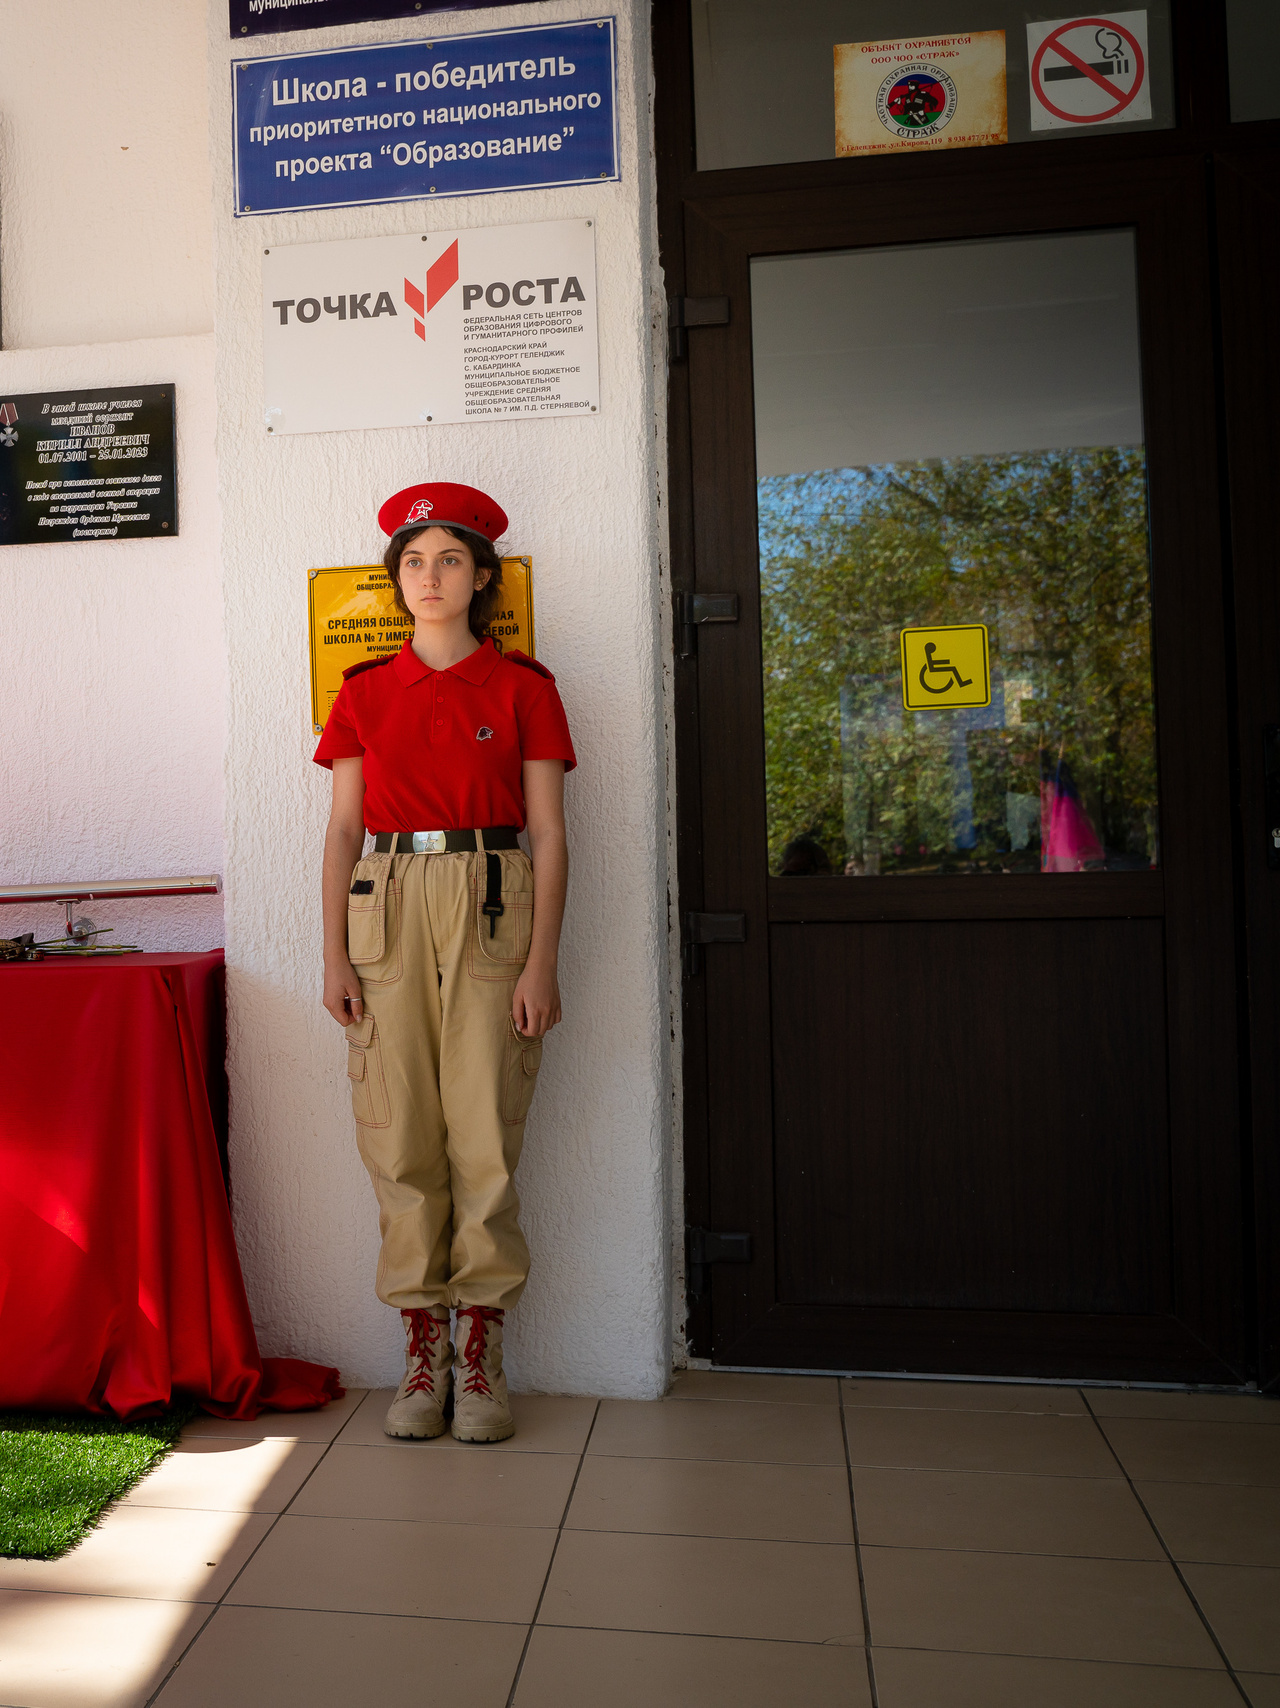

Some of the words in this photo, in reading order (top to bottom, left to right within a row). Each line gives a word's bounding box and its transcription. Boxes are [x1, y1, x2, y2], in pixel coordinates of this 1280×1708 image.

[871, 56, 891, 64] ООО
[916, 50, 960, 60] «СТРАЖ»
[272, 76, 367, 106] Школа
[395, 56, 576, 92] победитель
[878, 88, 888, 125] ЧАСТНАЯ
[886, 65, 928, 86] ОХРАННАЯ
[250, 108, 416, 146] приоритетного
[422, 92, 602, 126] национального
[896, 122, 940, 138] СТРАЖ
[275, 149, 372, 181] проекта
[380, 126, 576, 170] “Образование”
[272, 292, 398, 325] ТОЧКА
[462, 276, 586, 310] РОСТА
[464, 314, 521, 324] ФЕДЕРАЛЬНАЯ
[523, 312, 544, 320] СЕТЬ
[546, 310, 582, 318] ЦЕНТРОВ
[464, 322, 521, 332] ОБРАЗОВАНИЯ
[523, 318, 572, 328] ЦИФРОВОГО
[471, 330, 538, 340] ГУМАНИТАРНОГО
[540, 325, 584, 336] ПРОФИЛЕЙ
[464, 342, 527, 354] КРАСНОДАРСКИЙ
[528, 341, 548, 350] КРАЙ
[464, 352, 518, 363] ГОРОД-КУРОРТ
[520, 350, 565, 359] ГЕЛЕНДЖИК
[464, 370, 530, 380] МУНИЦИПАЛЬНОЕ
[532, 366, 580, 376] БЮДЖЕТНОЕ
[473, 362, 522, 371] КАБАРДИНКА
[464, 376, 560, 389] ОБЩЕОБРАЗОВАТЕЛЬНОЕ
[464, 388, 514, 398] УЧРЕЖДЕНИЕ
[516, 386, 552, 394] СРЕДНЯЯ
[41, 404, 50, 414] В
[51, 402, 76, 413] этой
[78, 402, 108, 412] школе
[108, 400, 142, 412] учился
[465, 394, 561, 406] ОБЩЕОБРАЗОВАТЕЛЬНАЯ
[466, 407, 492, 415] ШКОЛА
[524, 404, 538, 412] П.Д.
[540, 400, 590, 410] СТЕРНЯЕВОЙ
[51, 413, 92, 426] младший
[95, 412, 134, 424] сержант
[70, 424, 115, 437] ИВАНОВ
[36, 438, 82, 451] КИРИЛЛ
[84, 434, 150, 449] АНДРЕЕВИЧ
[38, 450, 87, 464] 01.07.2001
[98, 447, 148, 460] 25.01.2023
[25, 480, 48, 490] Погиб
[48, 480, 62, 489] при
[63, 478, 104, 487] исполнении
[106, 476, 140, 484] воинского
[142, 474, 162, 482] долга
[32, 492, 49, 501] ходе
[50, 490, 95, 500] специальной
[96, 488, 125, 497] военной
[126, 488, 160, 498] операции
[60, 503, 105, 514] территории
[106, 502, 138, 511] Украины
[80, 514, 110, 525] Орденом
[112, 513, 150, 524] Мужества
[72, 526, 118, 538] (посмертно)
[328, 618, 376, 630] СРЕДНЯЯ
[324, 634, 362, 644] ШКОЛА
[364, 632, 375, 642] №
[378, 632, 382, 642] 7
